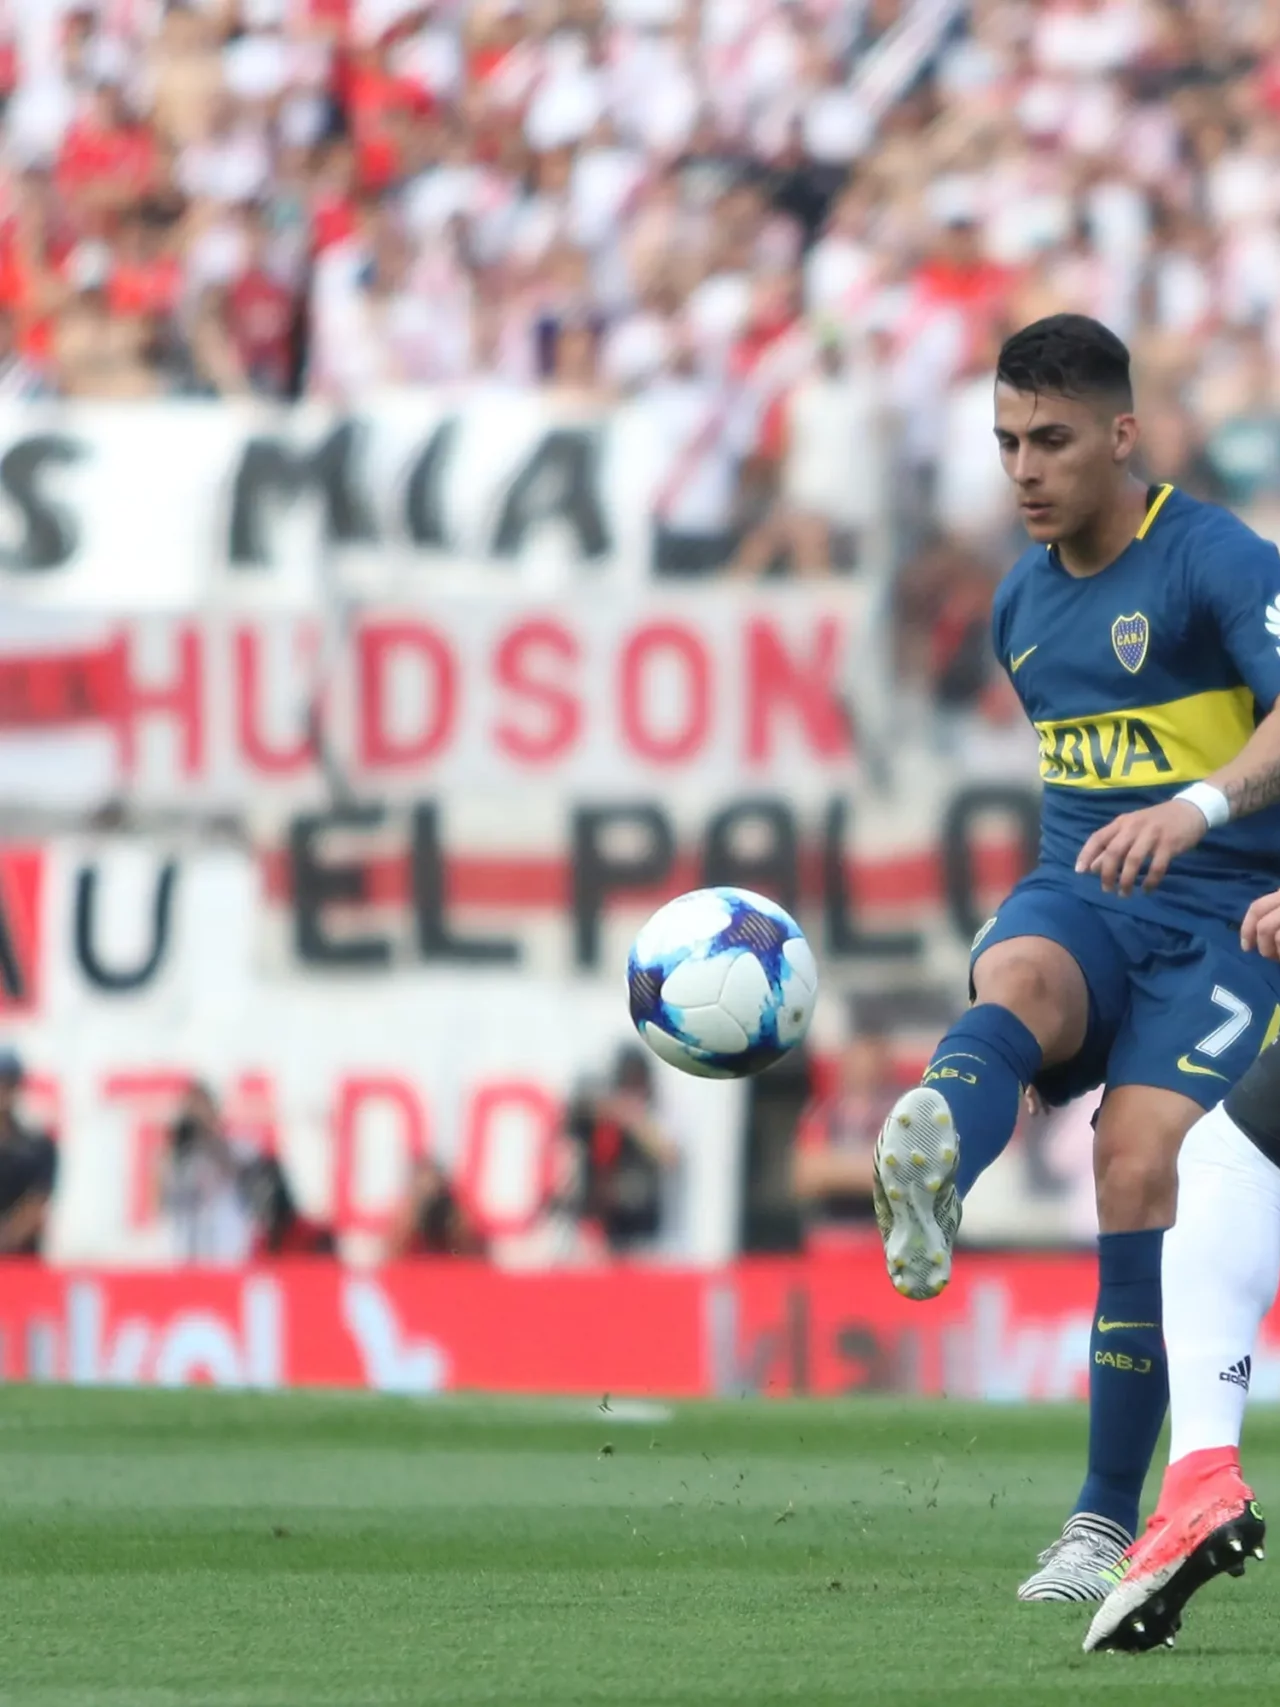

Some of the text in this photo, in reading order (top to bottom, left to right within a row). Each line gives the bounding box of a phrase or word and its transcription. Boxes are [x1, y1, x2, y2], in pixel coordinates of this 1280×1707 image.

[230, 418, 612, 568] MIA
[1117, 631, 1144, 646] CABJ
[110, 614, 850, 778] HUDSON
[1039, 718, 1173, 780] BBVA
[290, 788, 520, 968] EL
[1194, 984, 1252, 1057] 7
[921, 1066, 977, 1085] ABJ
[1095, 1351, 1152, 1374] CABJ
